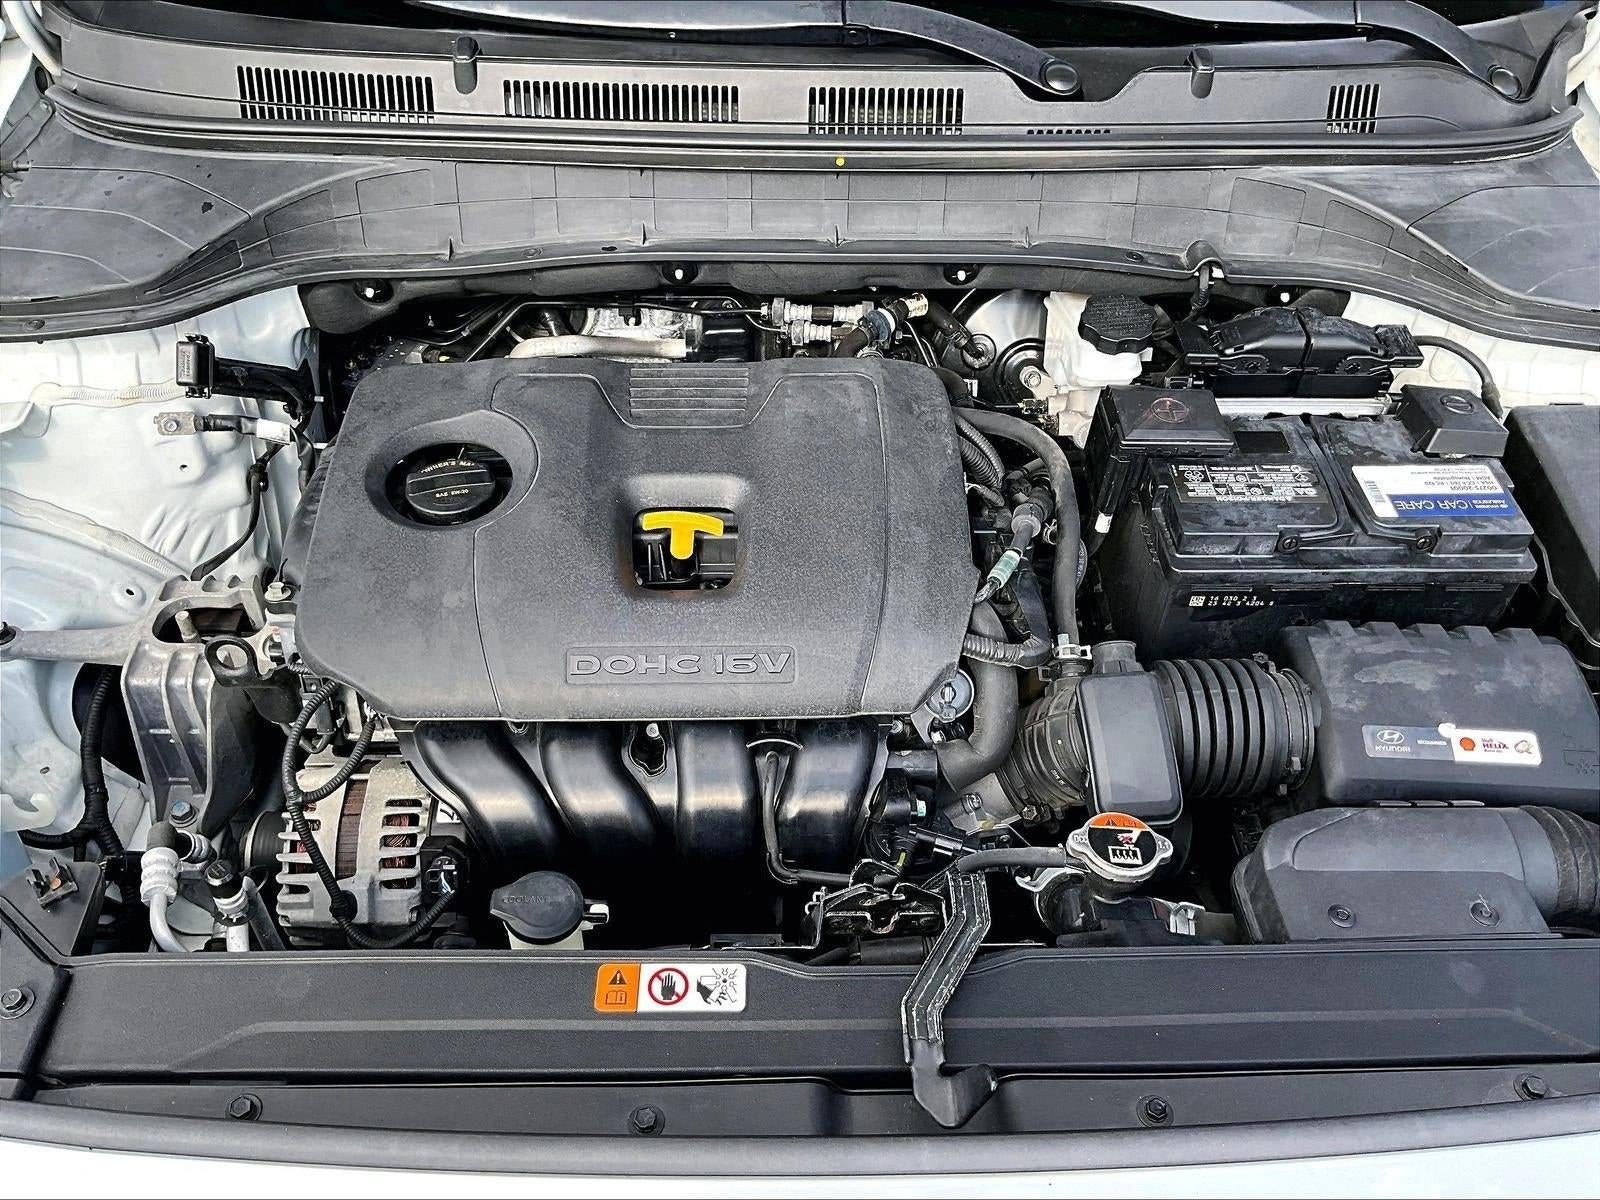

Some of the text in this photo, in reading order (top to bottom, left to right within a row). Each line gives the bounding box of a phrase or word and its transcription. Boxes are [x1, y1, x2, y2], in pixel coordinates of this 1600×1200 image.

[1393, 500, 1468, 510] CAR CARE
[569, 652, 792, 676] DOHC 16V
[1375, 745, 1411, 753] HYUNDAI
[503, 895, 549, 904] COOLANT
